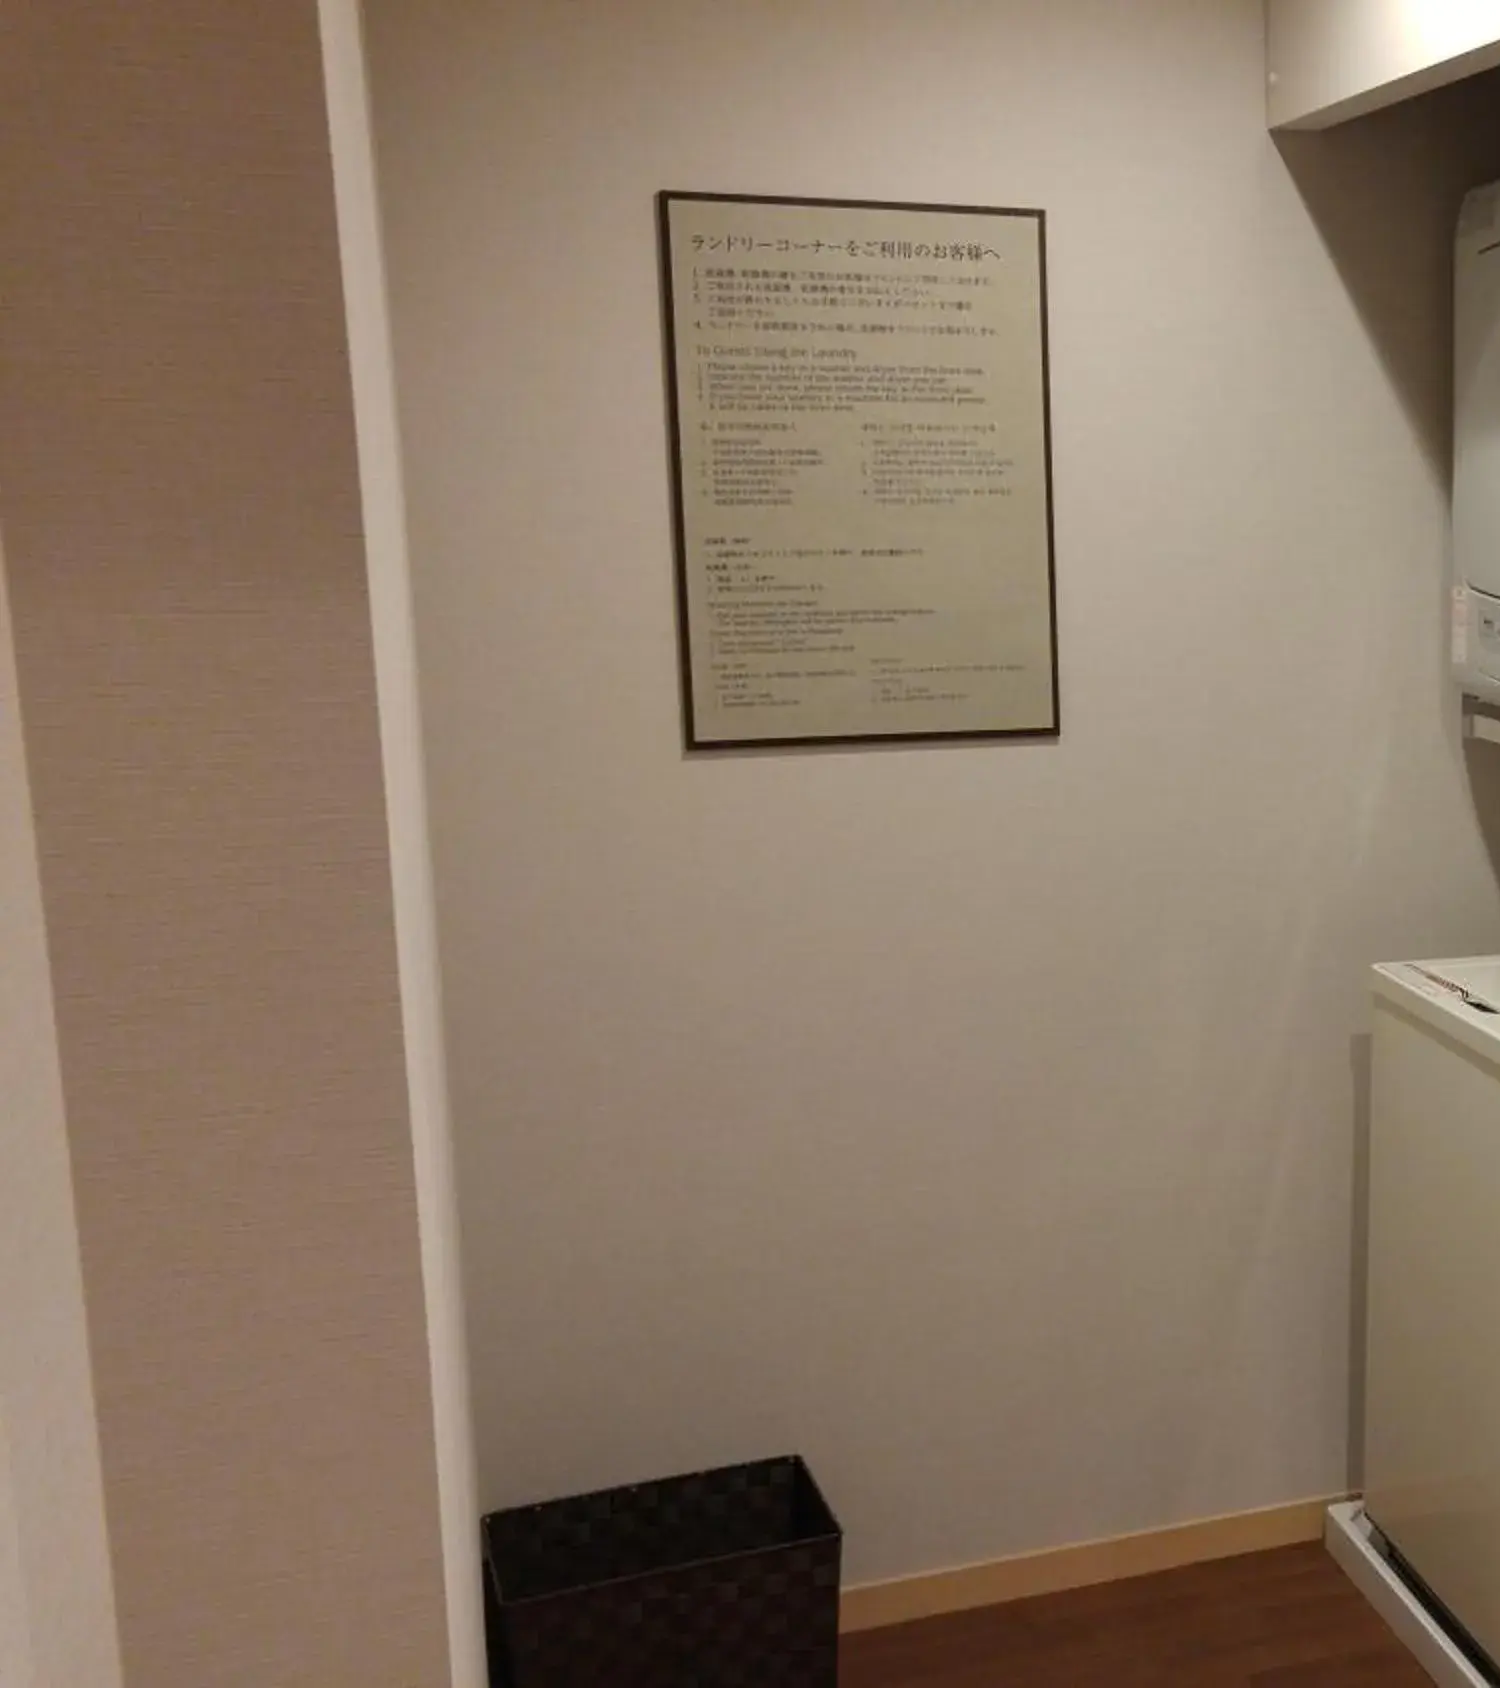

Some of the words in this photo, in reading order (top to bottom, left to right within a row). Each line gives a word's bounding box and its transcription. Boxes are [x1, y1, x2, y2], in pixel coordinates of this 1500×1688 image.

[691, 235, 1001, 261] ランドリーコーナーをご利用のお客様へ
